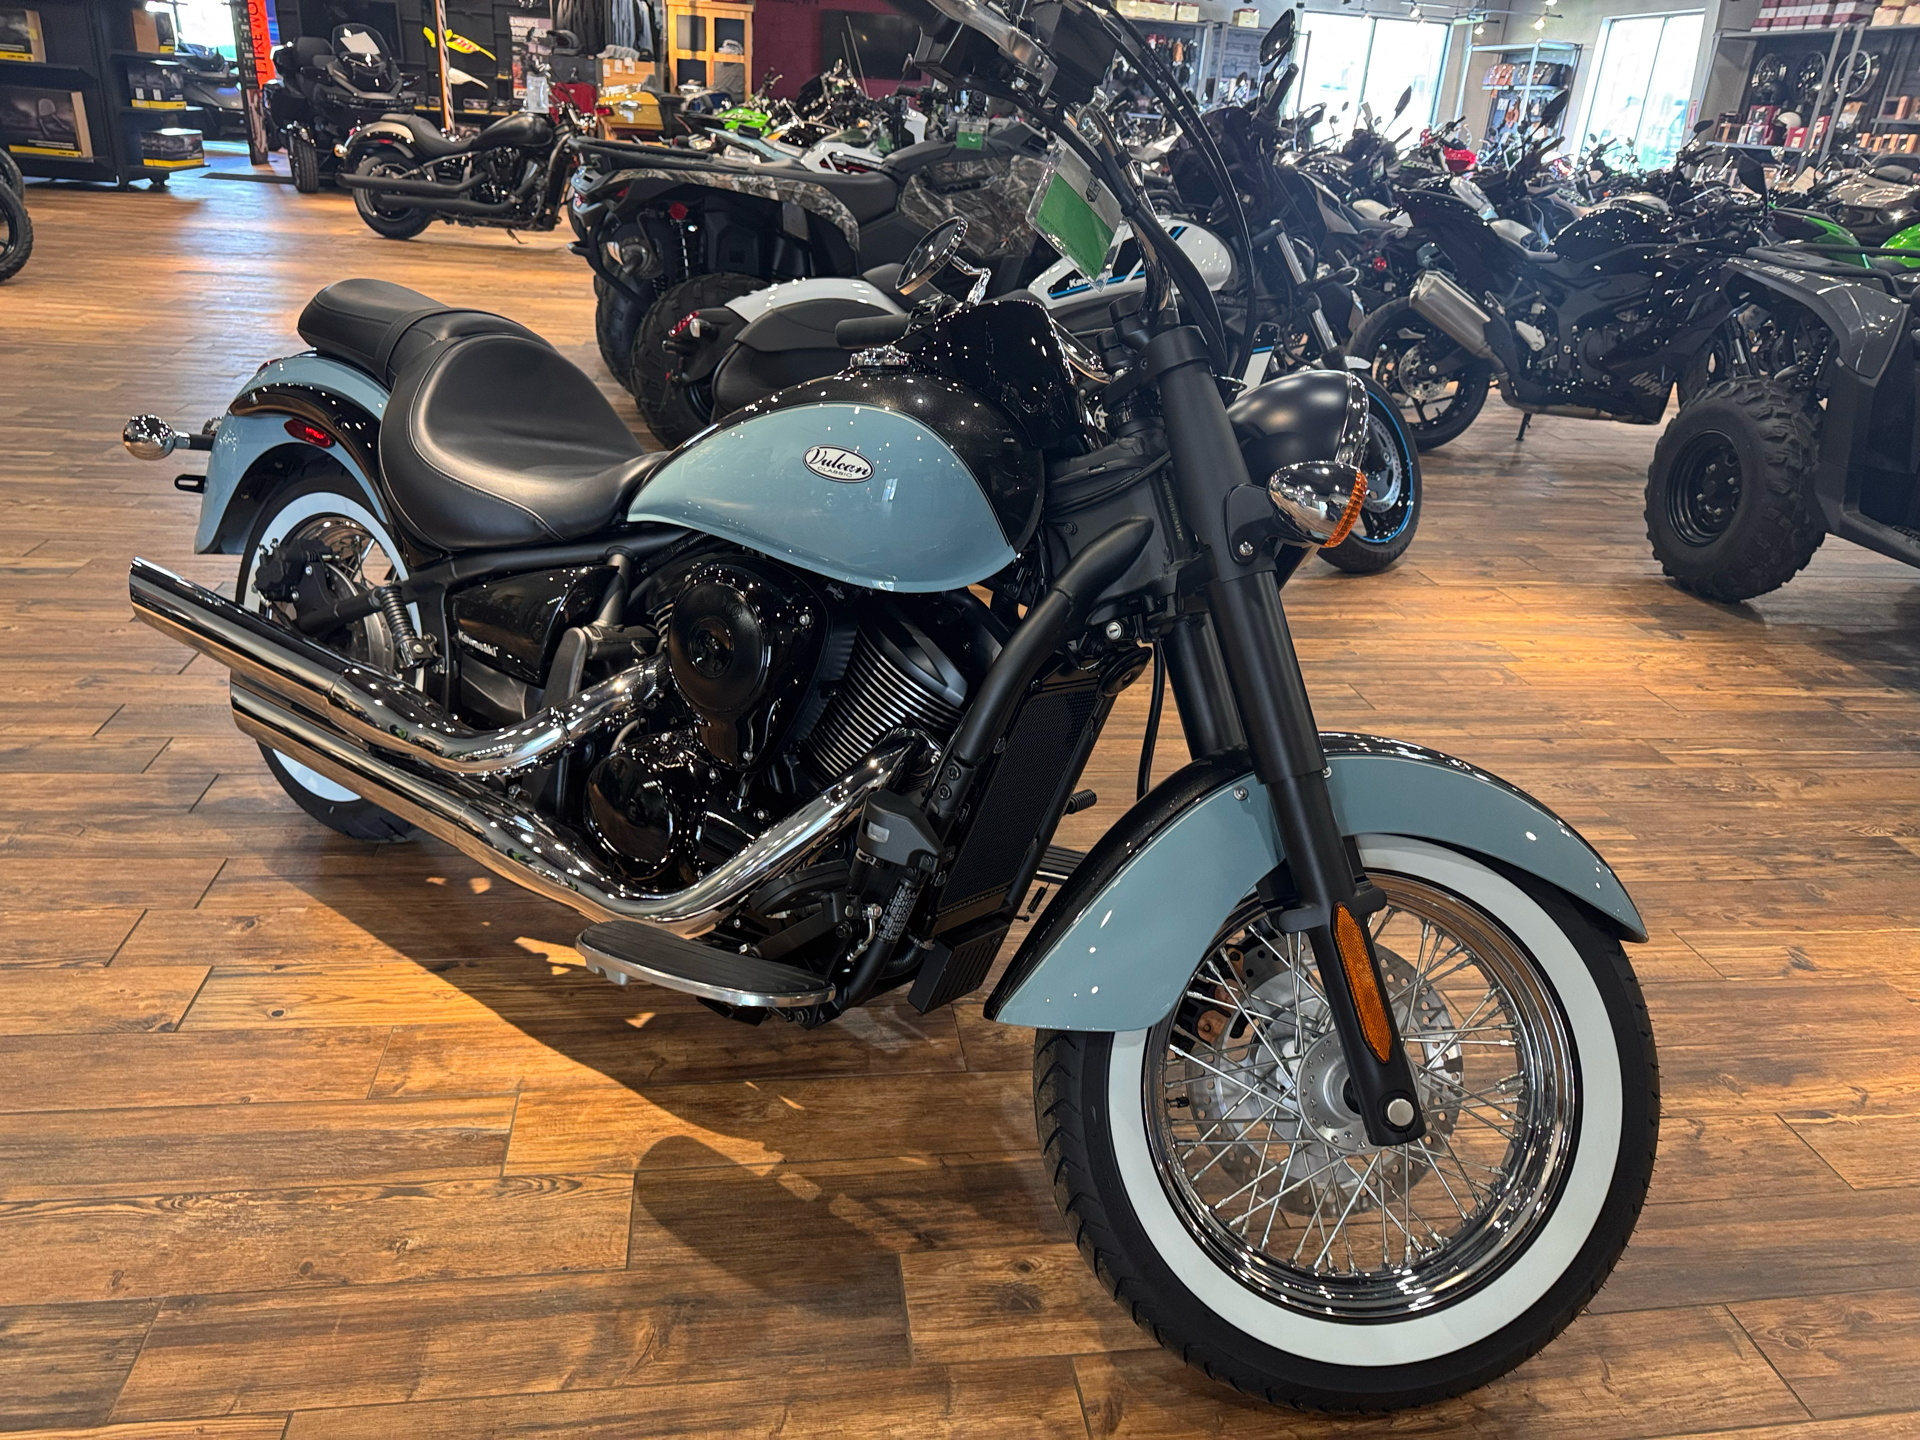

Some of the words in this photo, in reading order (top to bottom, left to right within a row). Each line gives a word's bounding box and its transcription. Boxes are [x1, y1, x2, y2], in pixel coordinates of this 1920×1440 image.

[807, 447, 870, 476] Vulcan
[817, 466, 853, 478] CLASSIC
[457, 629, 498, 658] Kawasaki
